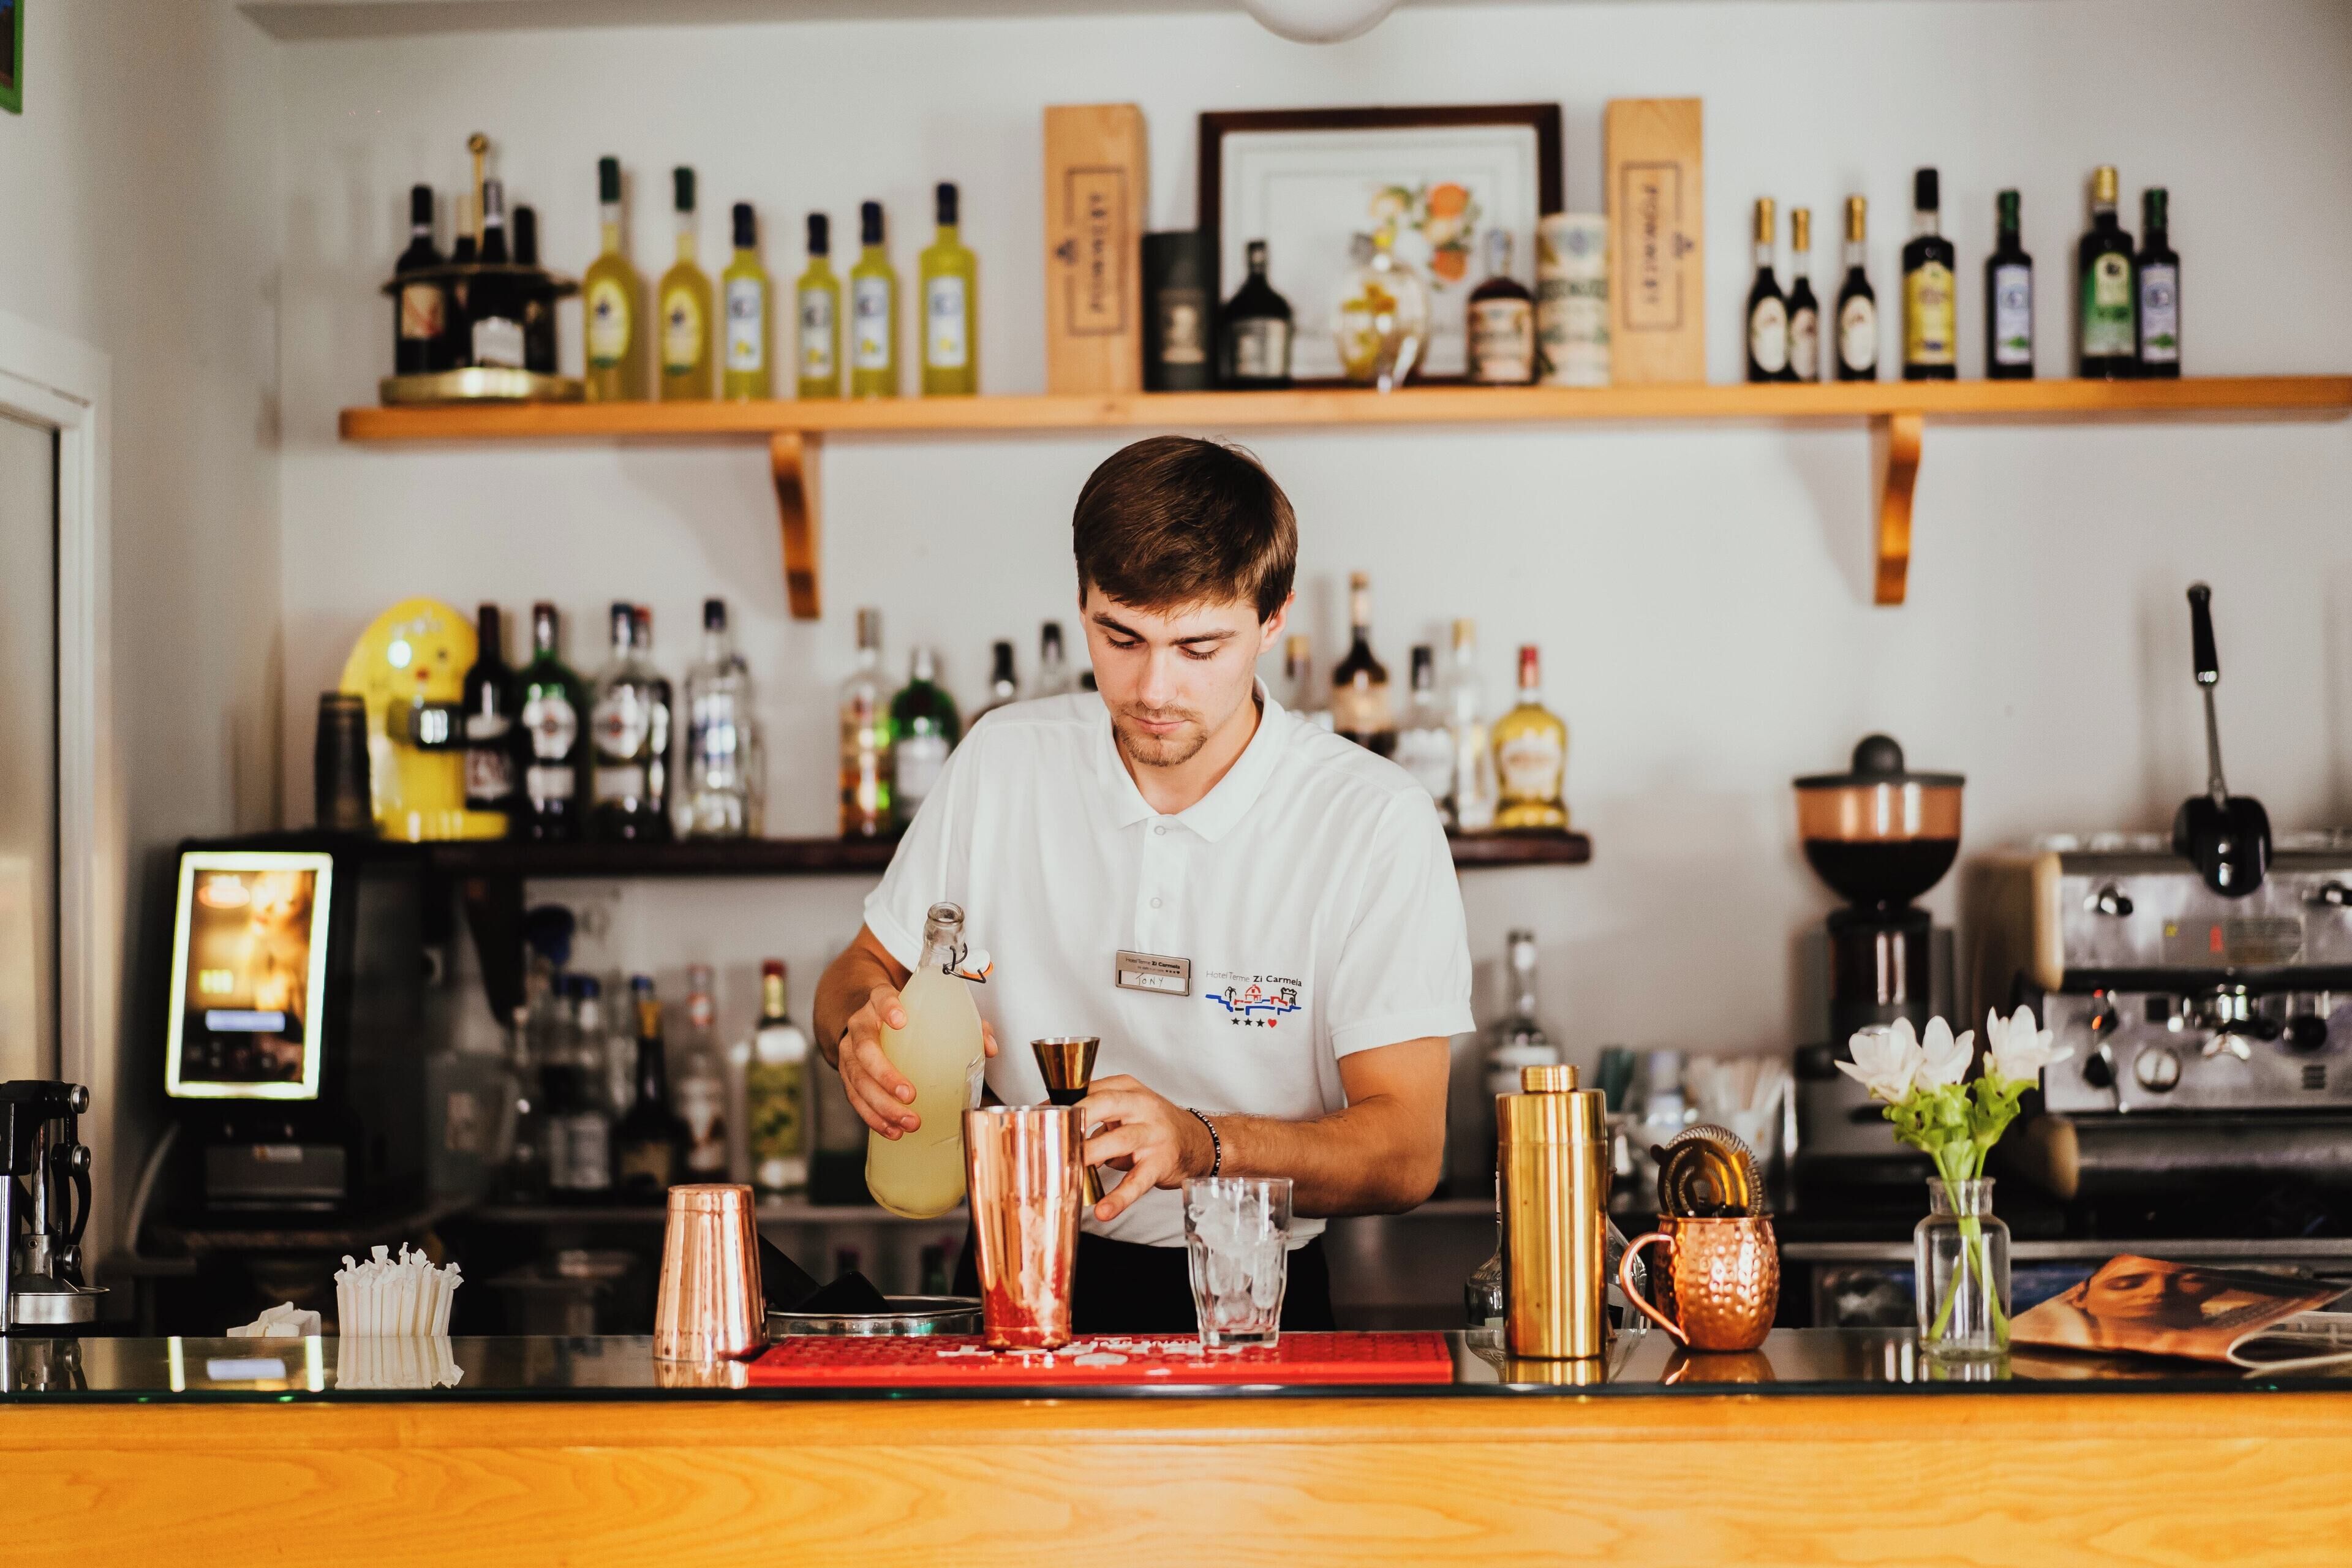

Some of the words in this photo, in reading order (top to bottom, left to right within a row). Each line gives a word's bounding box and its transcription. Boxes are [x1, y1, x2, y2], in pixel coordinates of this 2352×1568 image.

[1136, 973, 1164, 987] TONY
[1206, 970, 1227, 979] Hotel
[1229, 971, 1250, 982] Terme
[1266, 976, 1302, 987] Carmela
